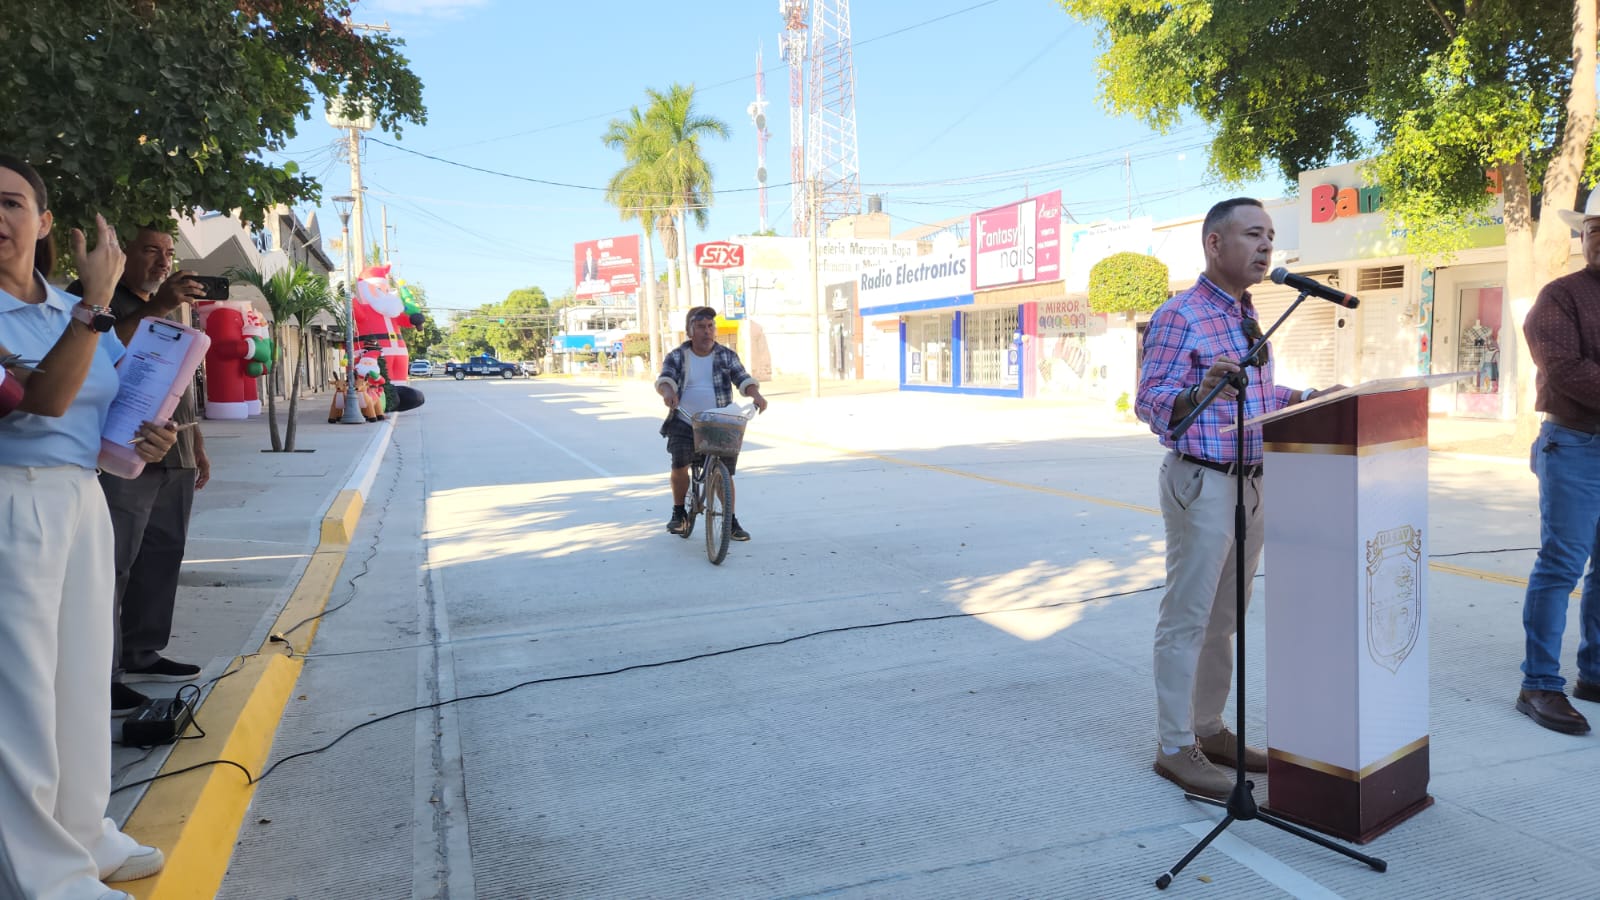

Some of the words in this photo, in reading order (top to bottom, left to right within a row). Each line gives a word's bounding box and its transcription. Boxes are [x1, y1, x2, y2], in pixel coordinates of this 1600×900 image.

[981, 220, 1018, 249] Fantasy
[1000, 224, 1034, 268] nails
[892, 243, 911, 259] Ropa
[861, 268, 892, 291] Radio
[896, 253, 967, 285] Electronics
[1045, 300, 1080, 314] MIRROR
